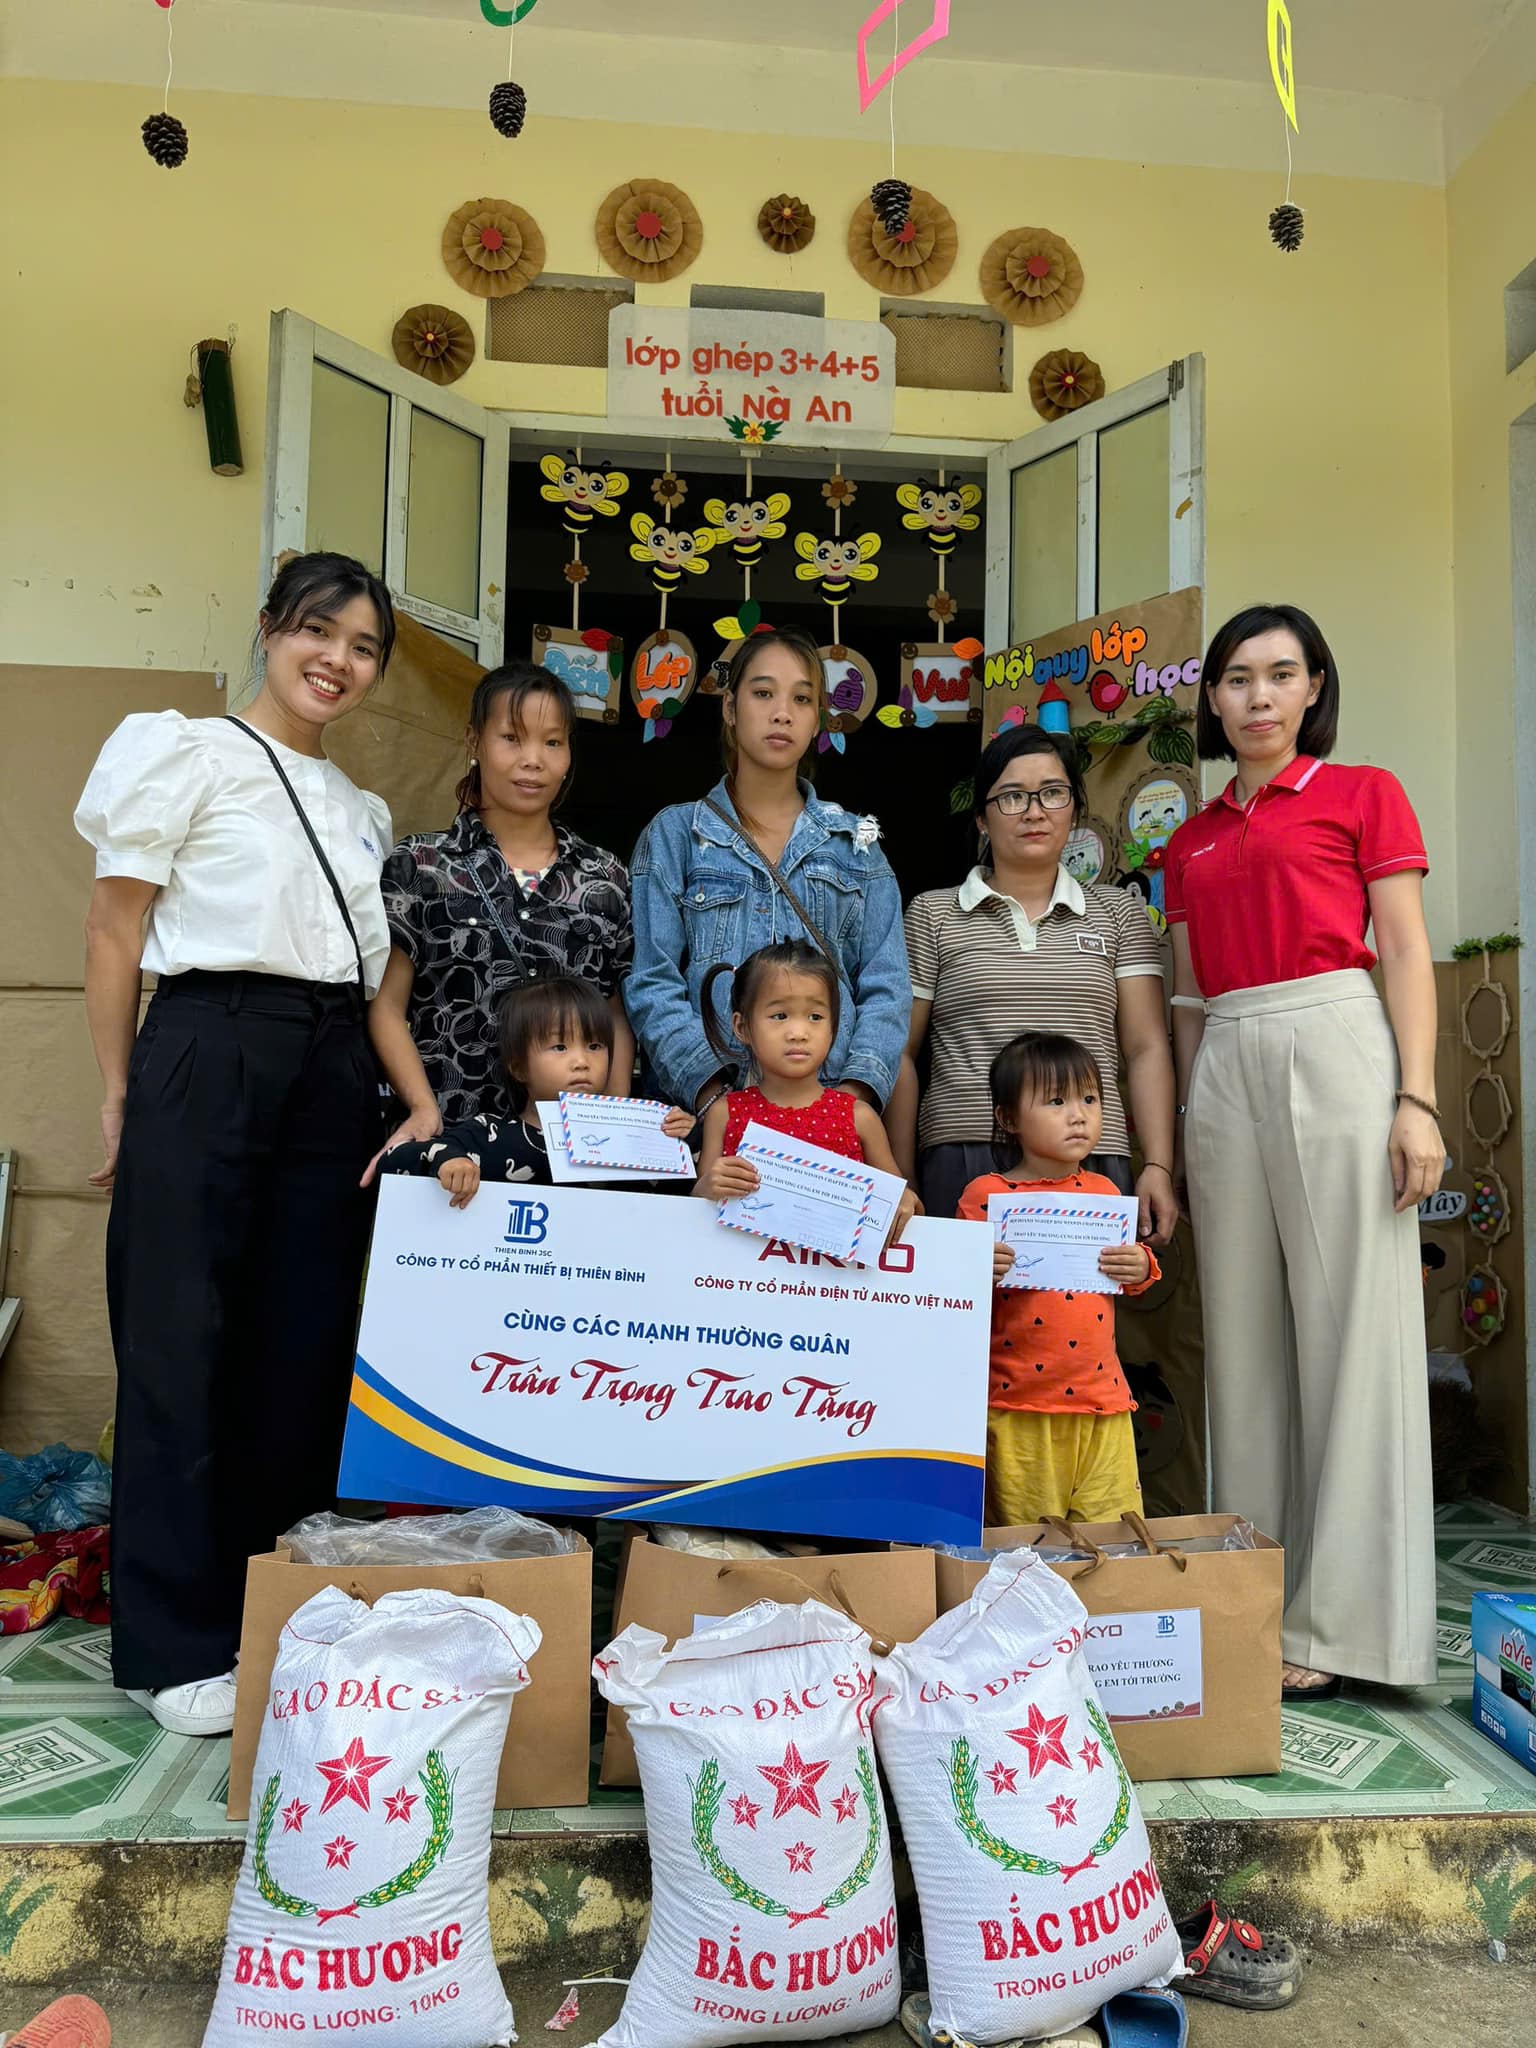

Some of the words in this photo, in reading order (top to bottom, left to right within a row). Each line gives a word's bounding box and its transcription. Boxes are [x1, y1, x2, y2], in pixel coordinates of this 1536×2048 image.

[626, 336, 680, 375] lớp
[692, 341, 773, 377] ghép
[779, 348, 880, 382] 3+4+5
[661, 380, 723, 416] tuổi
[742, 385, 791, 421] Nà
[805, 395, 852, 423] An
[636, 650, 691, 690] Lớp
[984, 644, 1034, 691] Nội
[1033, 645, 1089, 685] quy
[1091, 620, 1148, 666] lớp
[912, 665, 975, 702] Vui
[1133, 657, 1200, 697] học
[396, 1252, 437, 1267] CÔNG
[441, 1257, 456, 1269] TY
[459, 1254, 480, 1271] CỔ
[484, 1257, 520, 1273] PHẦN
[524, 1261, 557, 1276] THIẾT
[560, 1266, 572, 1281] BỊ
[576, 1266, 611, 1281] THIÊN
[615, 1268, 645, 1282] BÌNH
[494, 1246, 517, 1255] THIEN
[518, 1248, 538, 1256] BINH
[539, 1249, 553, 1257] JSC
[694, 1275, 735, 1290] CÔNG
[738, 1280, 752, 1291] TY
[756, 1277, 777, 1293] CỔ
[781, 1280, 816, 1297] PHẦN
[820, 1286, 849, 1301] ĐIỆN
[853, 1287, 868, 1301] TỬ
[871, 1292, 910, 1305] AIKYO
[914, 1294, 940, 1309] VIỆT
[943, 1298, 973, 1311] NAM
[504, 1309, 566, 1332] CÙNG
[573, 1314, 621, 1336] CÁC
[627, 1321, 690, 1344] MẠNH
[696, 1325, 783, 1349] THƯỜNG
[790, 1333, 850, 1355] QUÂN
[470, 1351, 561, 1395] Trân
[570, 1359, 677, 1421] Trọng
[686, 1367, 773, 1412] Trao
[782, 1376, 878, 1438] Tặng
[1085, 1624, 1122, 1640] KYO
[1088, 1662, 1109, 1673] RAO
[1111, 1660, 1130, 1671] YÊU
[1130, 1658, 1174, 1670] THƯƠNG
[1105, 1678, 1119, 1688] EM
[1122, 1675, 1138, 1686] TỚI
[1141, 1673, 1181, 1685] TRƯỜNG
[335, 1675, 413, 1713] ĐẶC
[753, 1684, 829, 1720] ĐẶC
[978, 1892, 1063, 1961] BẮC
[234, 1932, 305, 1991] BẮC
[317, 1923, 463, 1991] HƯƠNG
[694, 1923, 776, 1991] BẮC
[786, 1906, 896, 1992] HƯƠNG
[993, 1973, 1066, 2001] TRỌNG
[1072, 1943, 1139, 1986] LƯỢNG:
[1143, 1912, 1168, 1949] 10KG
[236, 2006, 305, 2033] TRỌNG
[313, 2005, 401, 2032] LƯỢNG:
[410, 1981, 461, 2015] 10KG
[692, 1996, 766, 2024] TRỌNG
[772, 1997, 852, 2025] LƯỢNG:
[858, 1968, 893, 2003] 10KG
